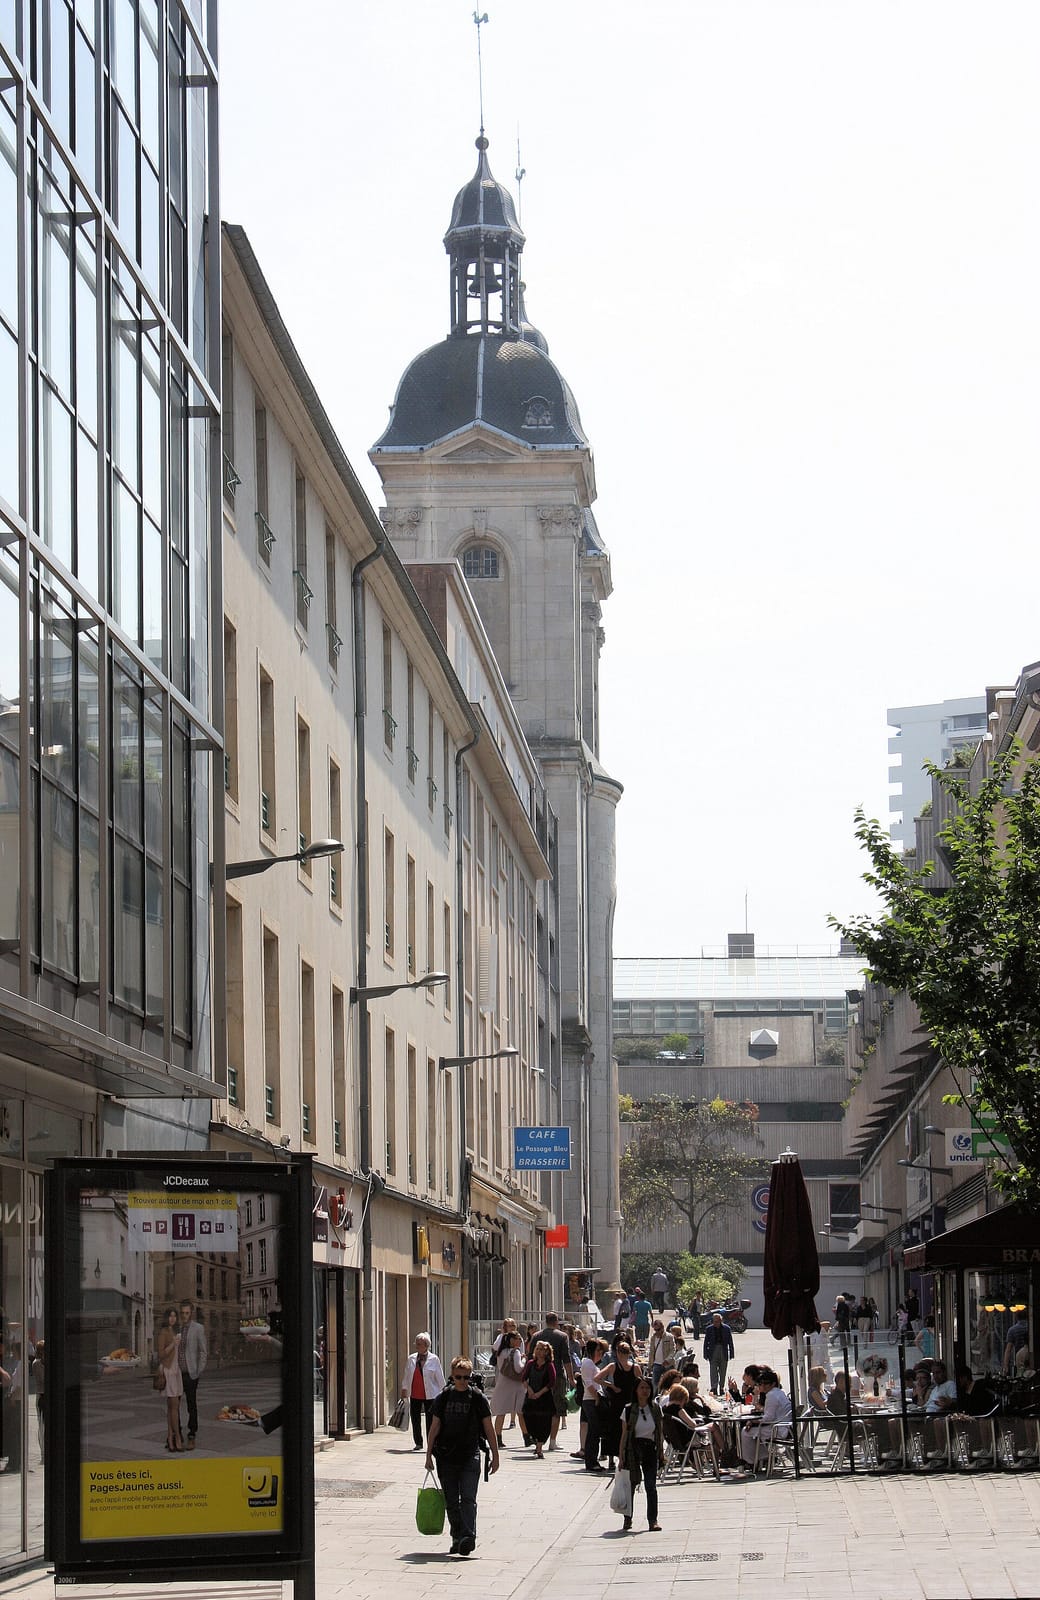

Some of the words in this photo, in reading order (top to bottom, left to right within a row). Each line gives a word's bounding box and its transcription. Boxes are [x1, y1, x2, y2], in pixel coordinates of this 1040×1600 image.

[528, 1130, 556, 1138] CAFE
[162, 1176, 210, 1186] JCDecaux
[116, 1470, 137, 1479] êtes
[90, 1482, 155, 1494] PagesJaunes
[157, 1480, 184, 1489] aussi.
